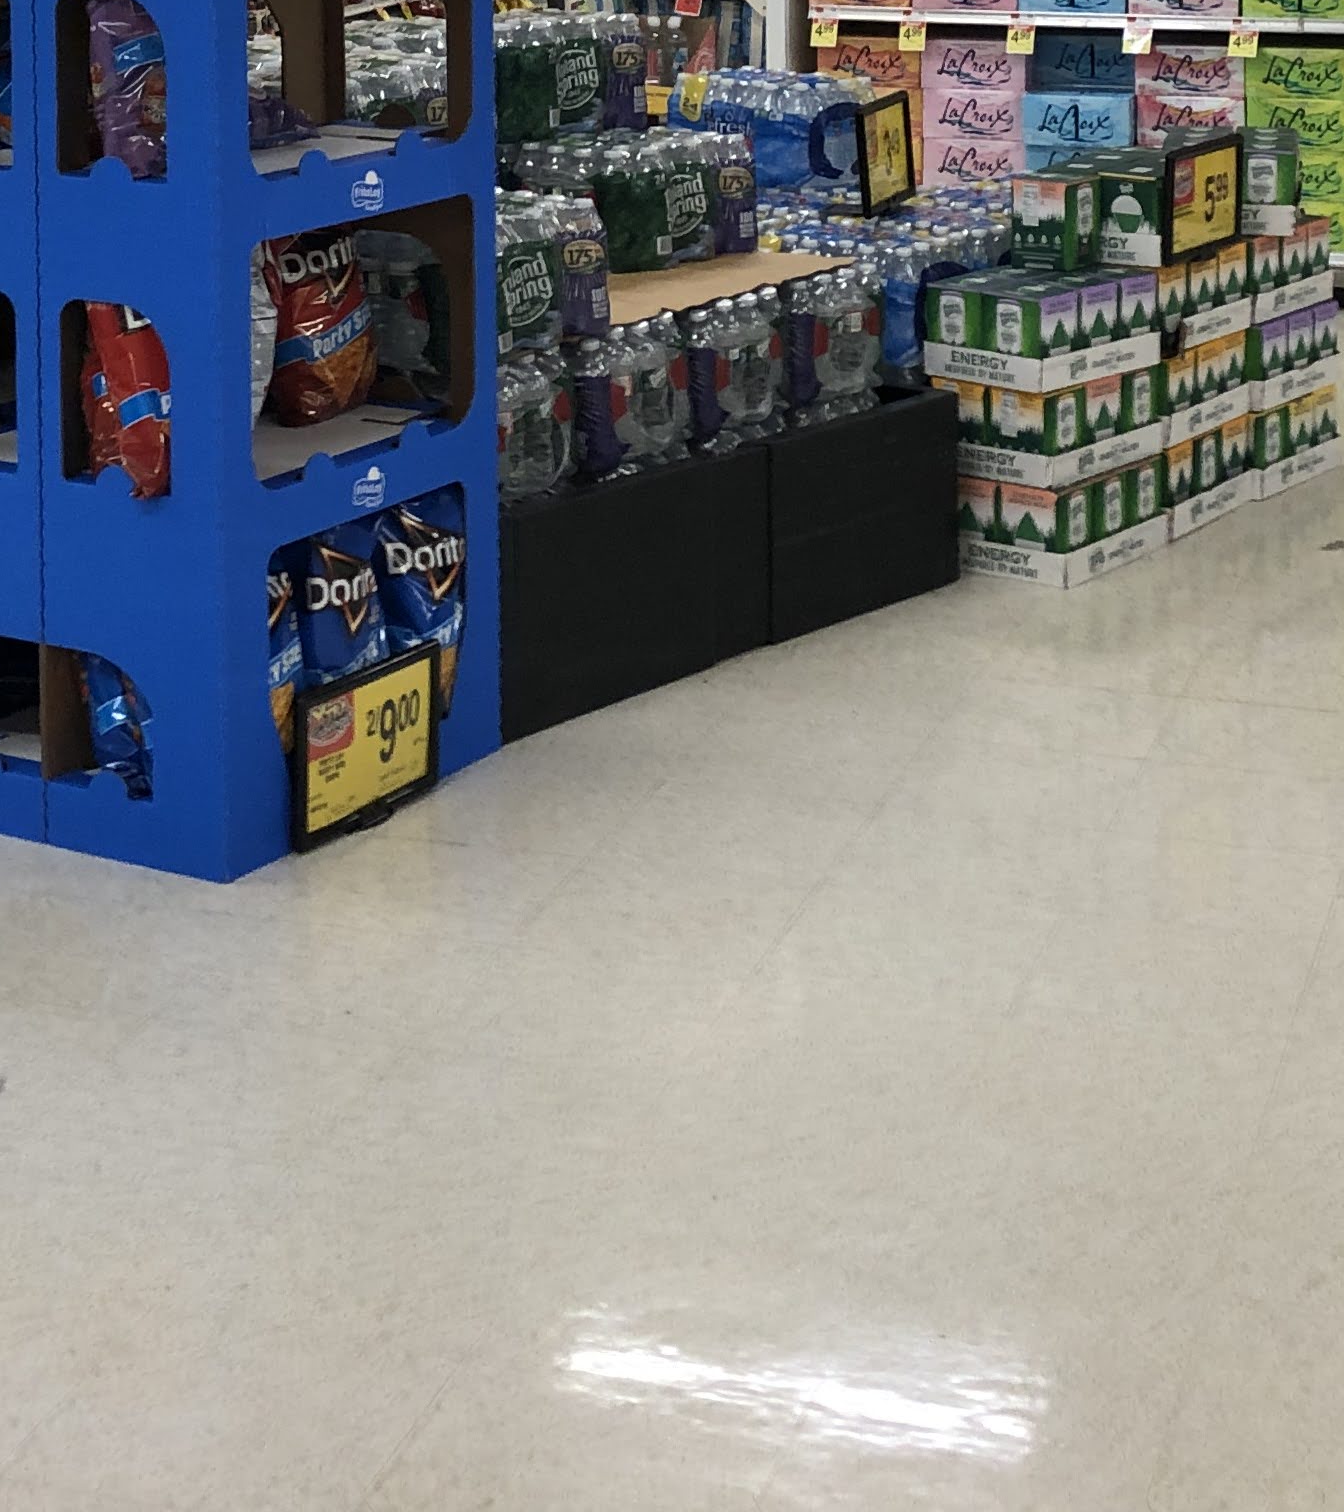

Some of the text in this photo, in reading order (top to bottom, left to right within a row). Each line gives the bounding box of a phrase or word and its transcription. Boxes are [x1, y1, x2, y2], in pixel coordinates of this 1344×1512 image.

[833, 44, 903, 72] LaCroix
[938, 44, 1009, 74] LaCroix
[1155, 49, 1224, 79] LaCroix
[1263, 55, 1336, 84] LaCroix
[939, 92, 1010, 123] LaCroix
[938, 142, 1008, 171] LaCroix
[567, 248, 594, 266] 175
[312, 320, 352, 358] Party
[950, 350, 1010, 371] ENERGY
